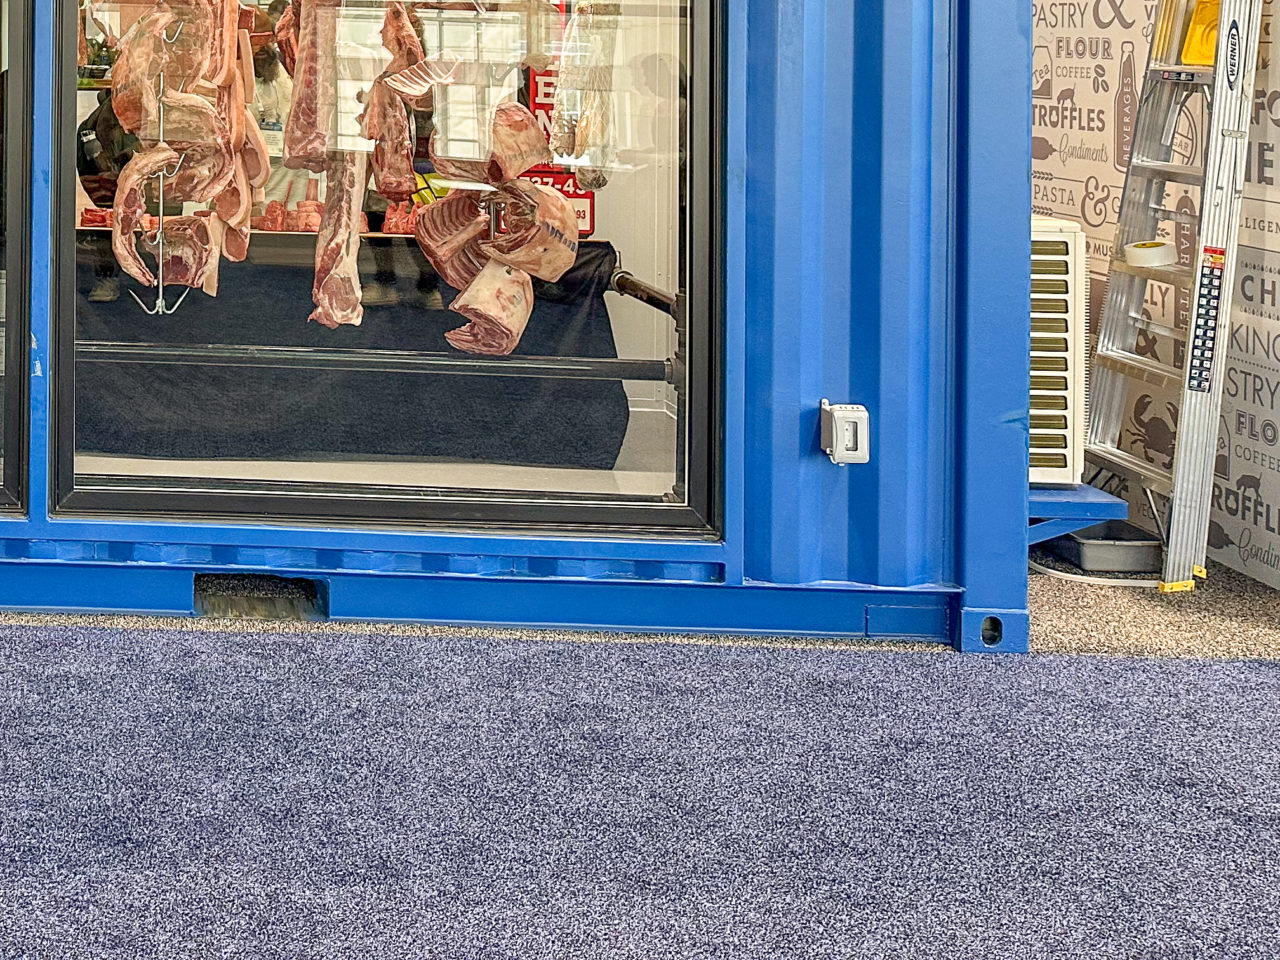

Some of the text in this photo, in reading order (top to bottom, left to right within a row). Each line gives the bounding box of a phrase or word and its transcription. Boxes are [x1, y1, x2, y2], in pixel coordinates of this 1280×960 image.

[1055, 36, 1114, 60] FLOUR
[1228, 32, 1238, 77] WERNER
[1032, 63, 1050, 84] Tea
[1055, 65, 1092, 79] COFFEE
[1057, 132, 1109, 167] Condiments
[1033, 183, 1076, 207] PASTA
